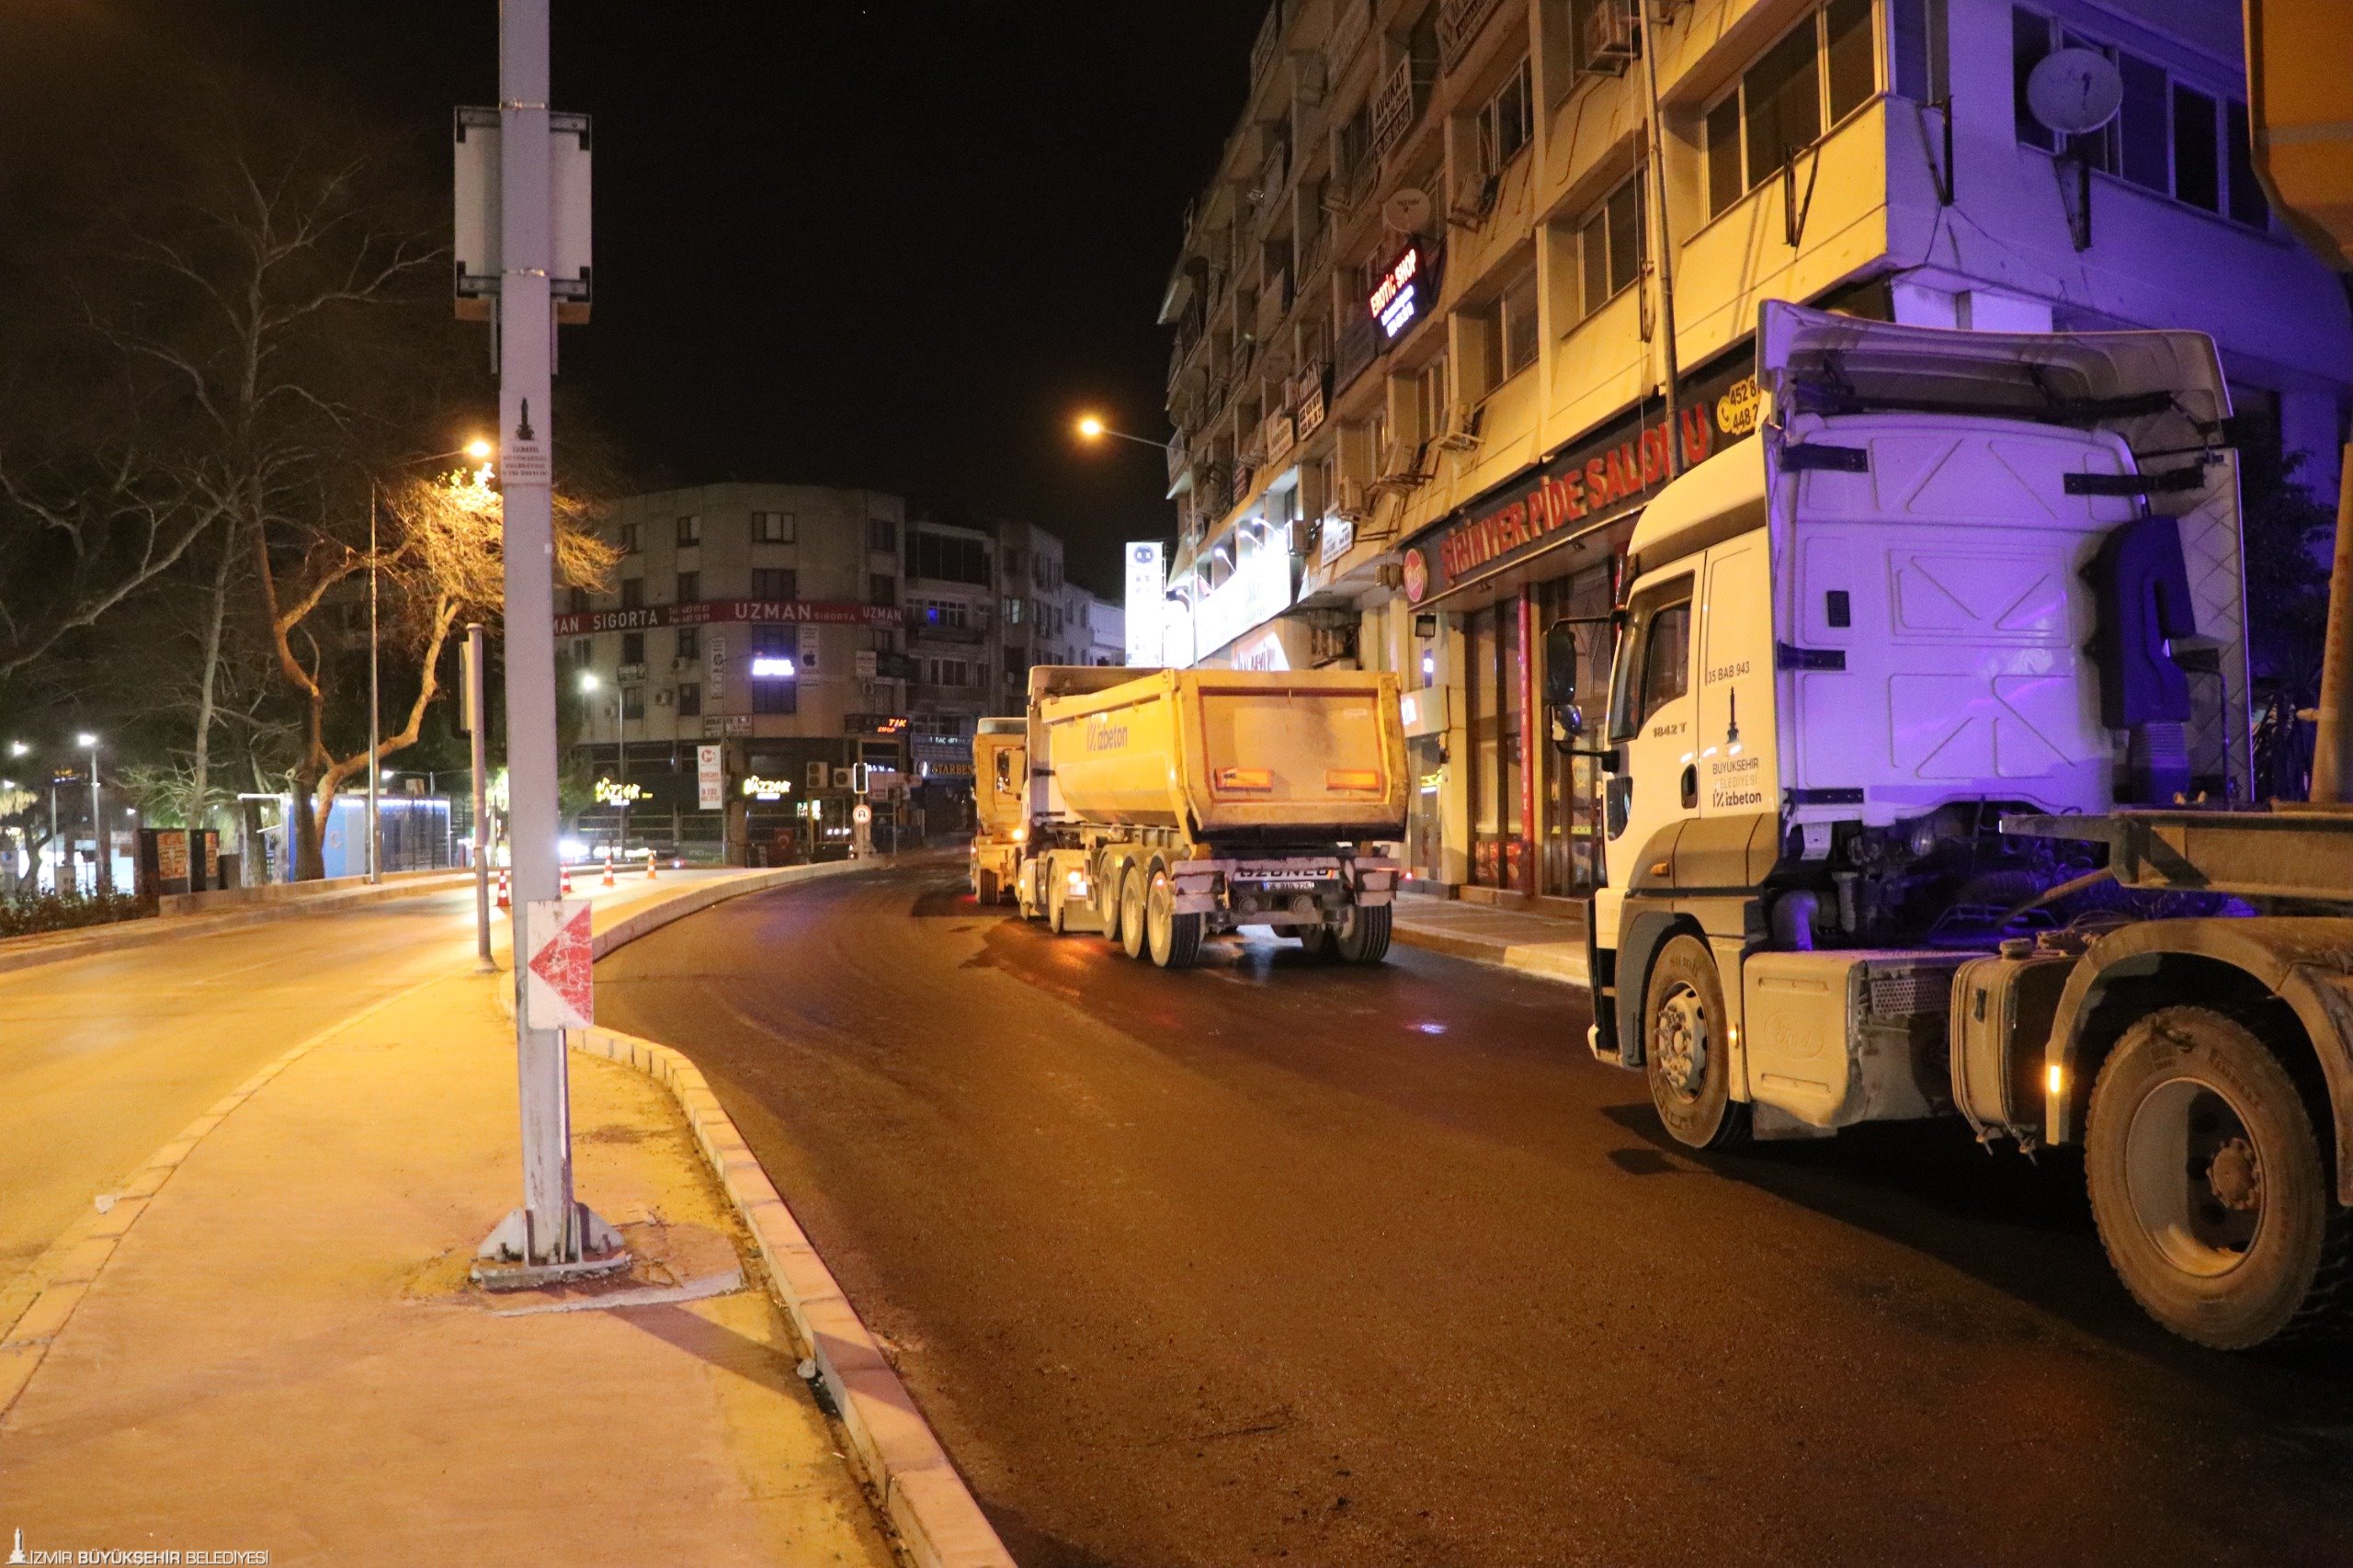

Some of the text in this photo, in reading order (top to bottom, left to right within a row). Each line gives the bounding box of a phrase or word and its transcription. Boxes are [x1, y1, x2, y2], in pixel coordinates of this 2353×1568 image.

[1395, 247, 1416, 289] SHOP
[1730, 384, 1748, 405] 452
[1733, 407, 1751, 430] 448
[1528, 470, 1587, 538] PİDE
[593, 610, 658, 631] SİGORTA
[735, 602, 812, 619] UZMAN
[862, 606, 902, 621] UZMAN
[1707, 661, 1750, 684] 35 BAB 943
[1653, 724, 1677, 738] 1842
[1725, 790, 1762, 807] izbeton
